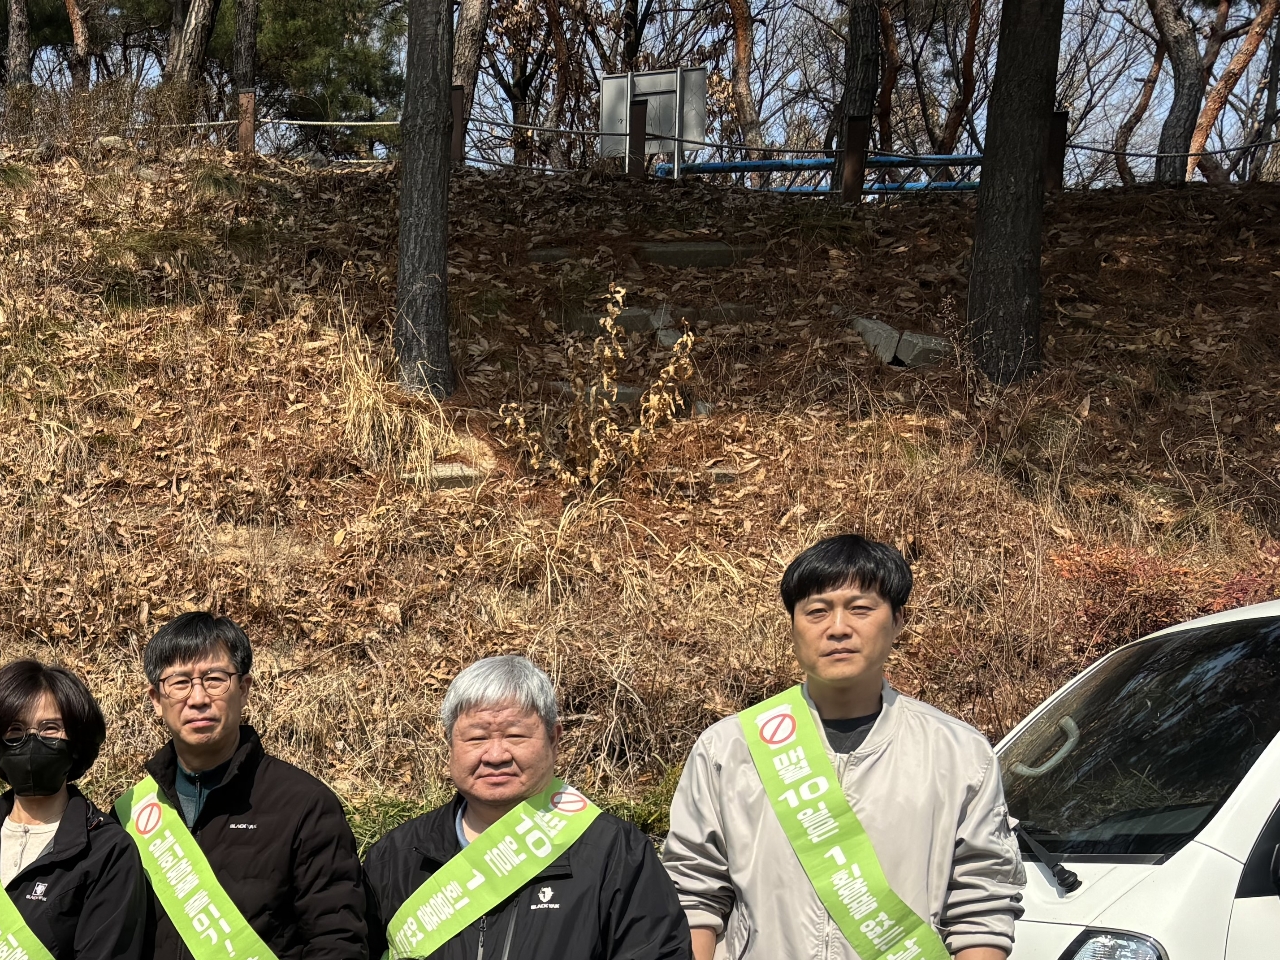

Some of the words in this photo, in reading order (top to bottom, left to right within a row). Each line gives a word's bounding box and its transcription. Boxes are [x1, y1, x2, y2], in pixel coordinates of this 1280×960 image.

[773, 746, 812, 785] 매월
[534, 809, 567, 838] 매월
[778, 776, 839, 843] 10일은
[484, 813, 552, 878] 10일은
[149, 829, 200, 899] 일회용품
[183, 889, 236, 958] 줄이기!
[417, 869, 485, 932] 1회용품
[824, 846, 878, 920] 1회용품
[860, 912, 905, 951] 없는
